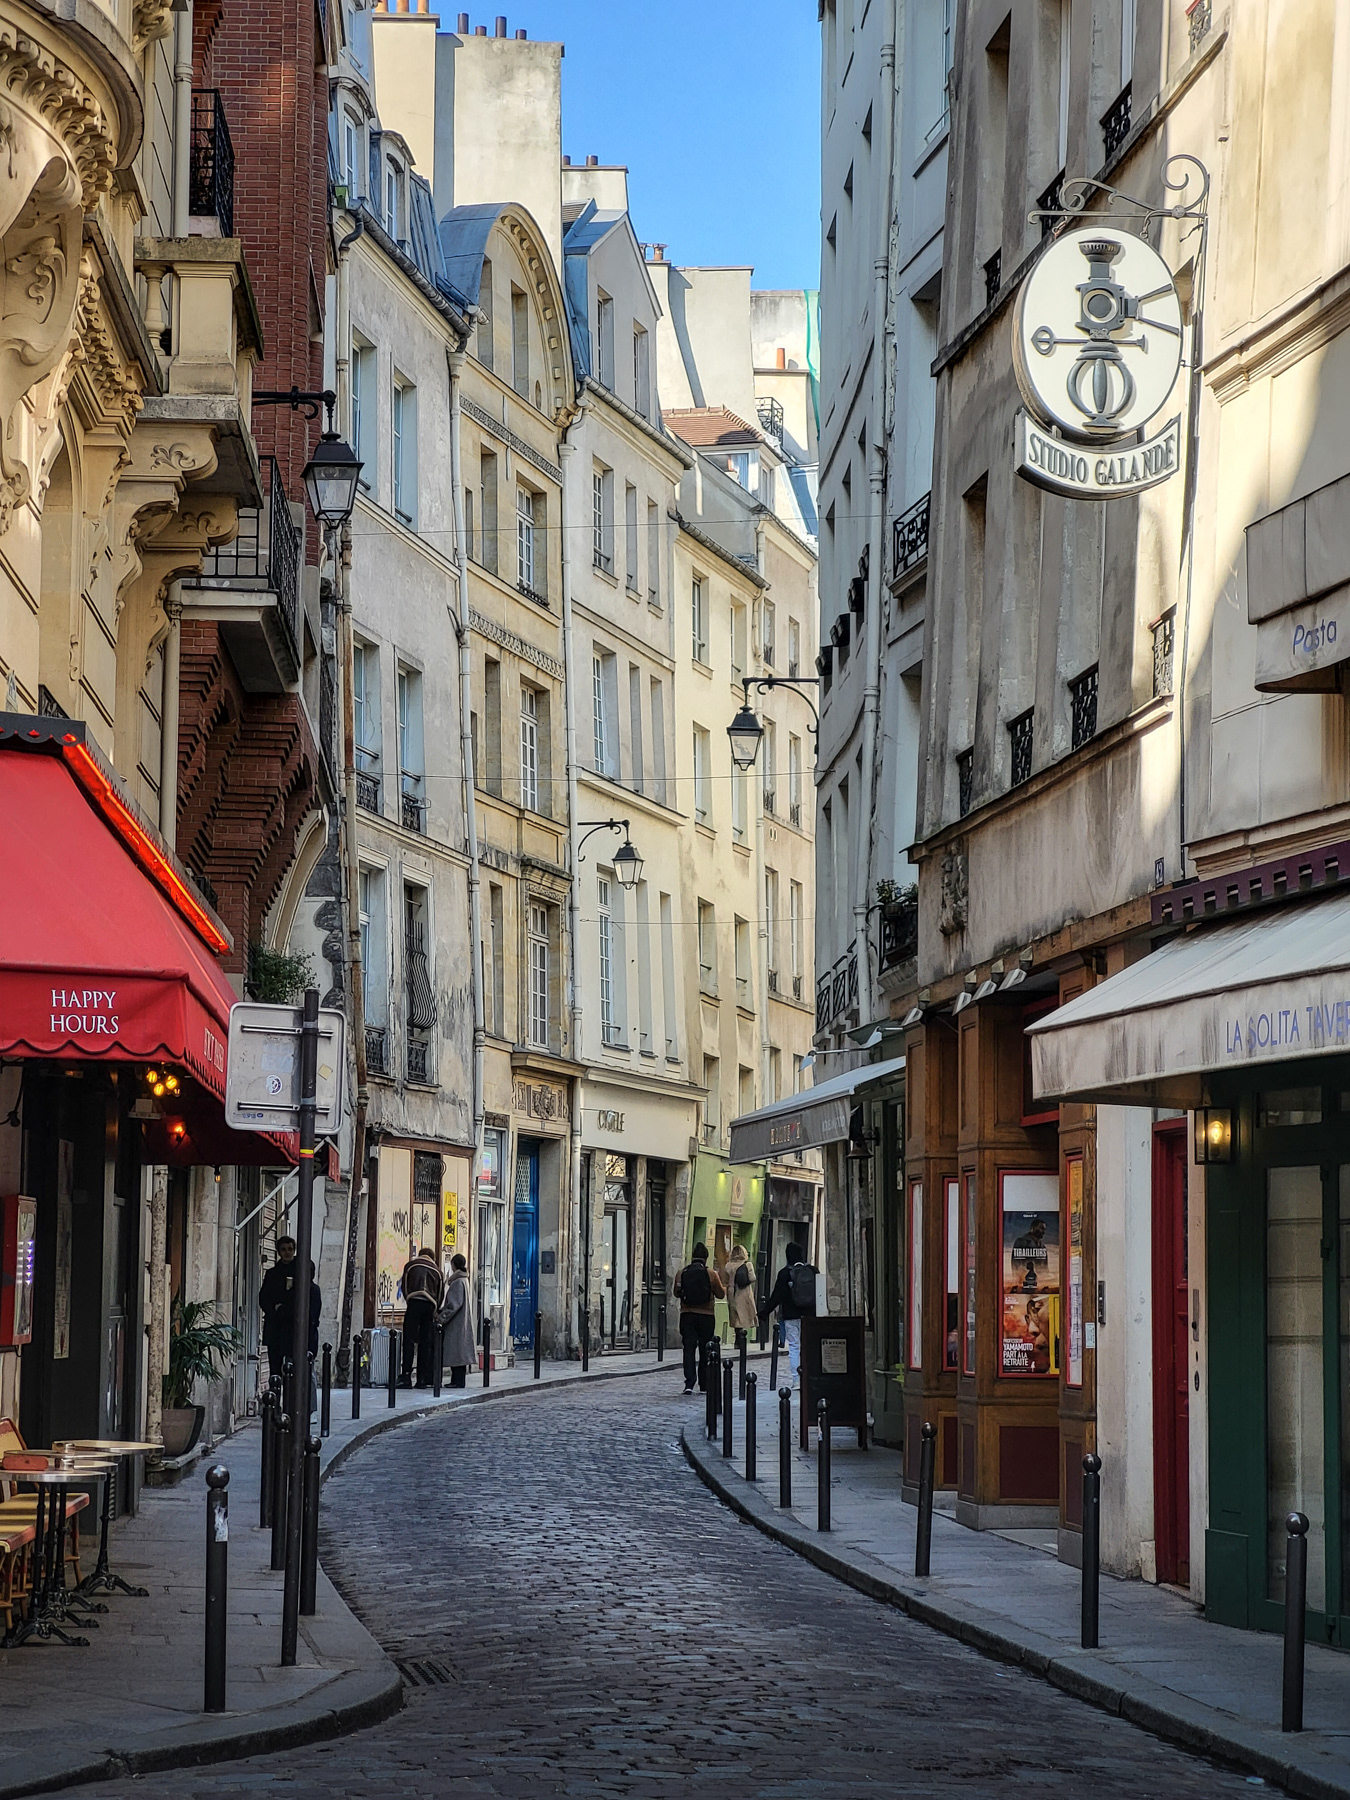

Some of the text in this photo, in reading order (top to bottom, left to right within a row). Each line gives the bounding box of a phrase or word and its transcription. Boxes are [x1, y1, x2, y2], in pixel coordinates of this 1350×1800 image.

[1029, 433, 1175, 485] STUDIO GALANDE
[1293, 618, 1337, 655] Pasta
[51, 989, 116, 1009] HAPPY
[50, 1014, 119, 1034] HOURS
[1226, 1019, 1243, 1053] LA
[1247, 1009, 1300, 1050] SOLITA
[1013, 1247, 1047, 1257] TIRAILLEURS
[1003, 1343, 1033, 1351] YAMAMOTO
[1003, 1358, 1029, 1366] RETRAITE
